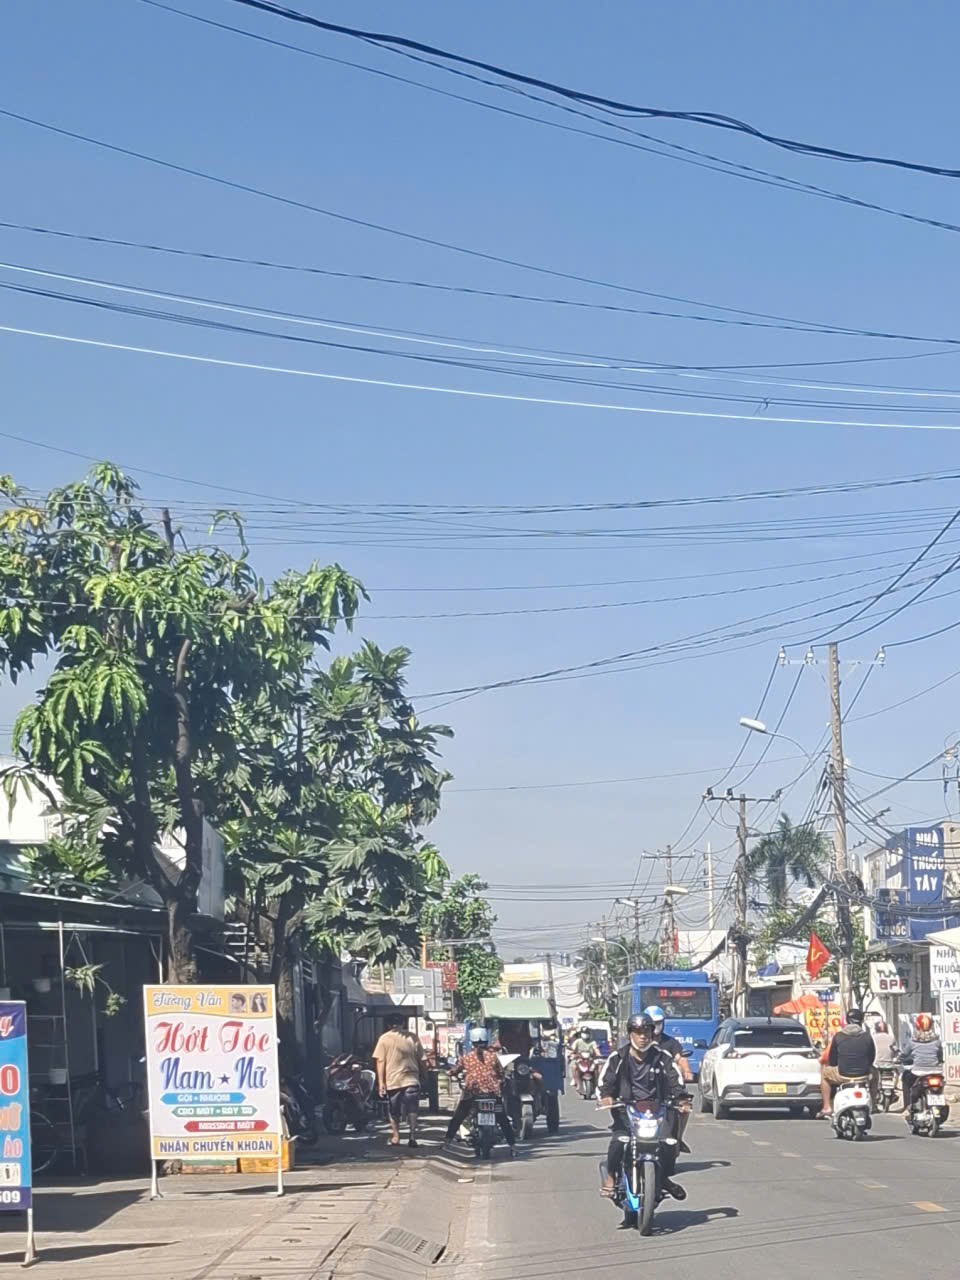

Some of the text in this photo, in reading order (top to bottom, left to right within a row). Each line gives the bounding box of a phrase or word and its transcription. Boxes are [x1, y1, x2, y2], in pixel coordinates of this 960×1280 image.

[915, 875, 938, 891] TÂY
[155, 1020, 271, 1053] Hớt Tóc
[161, 1057, 268, 1089] Nam Nữ
